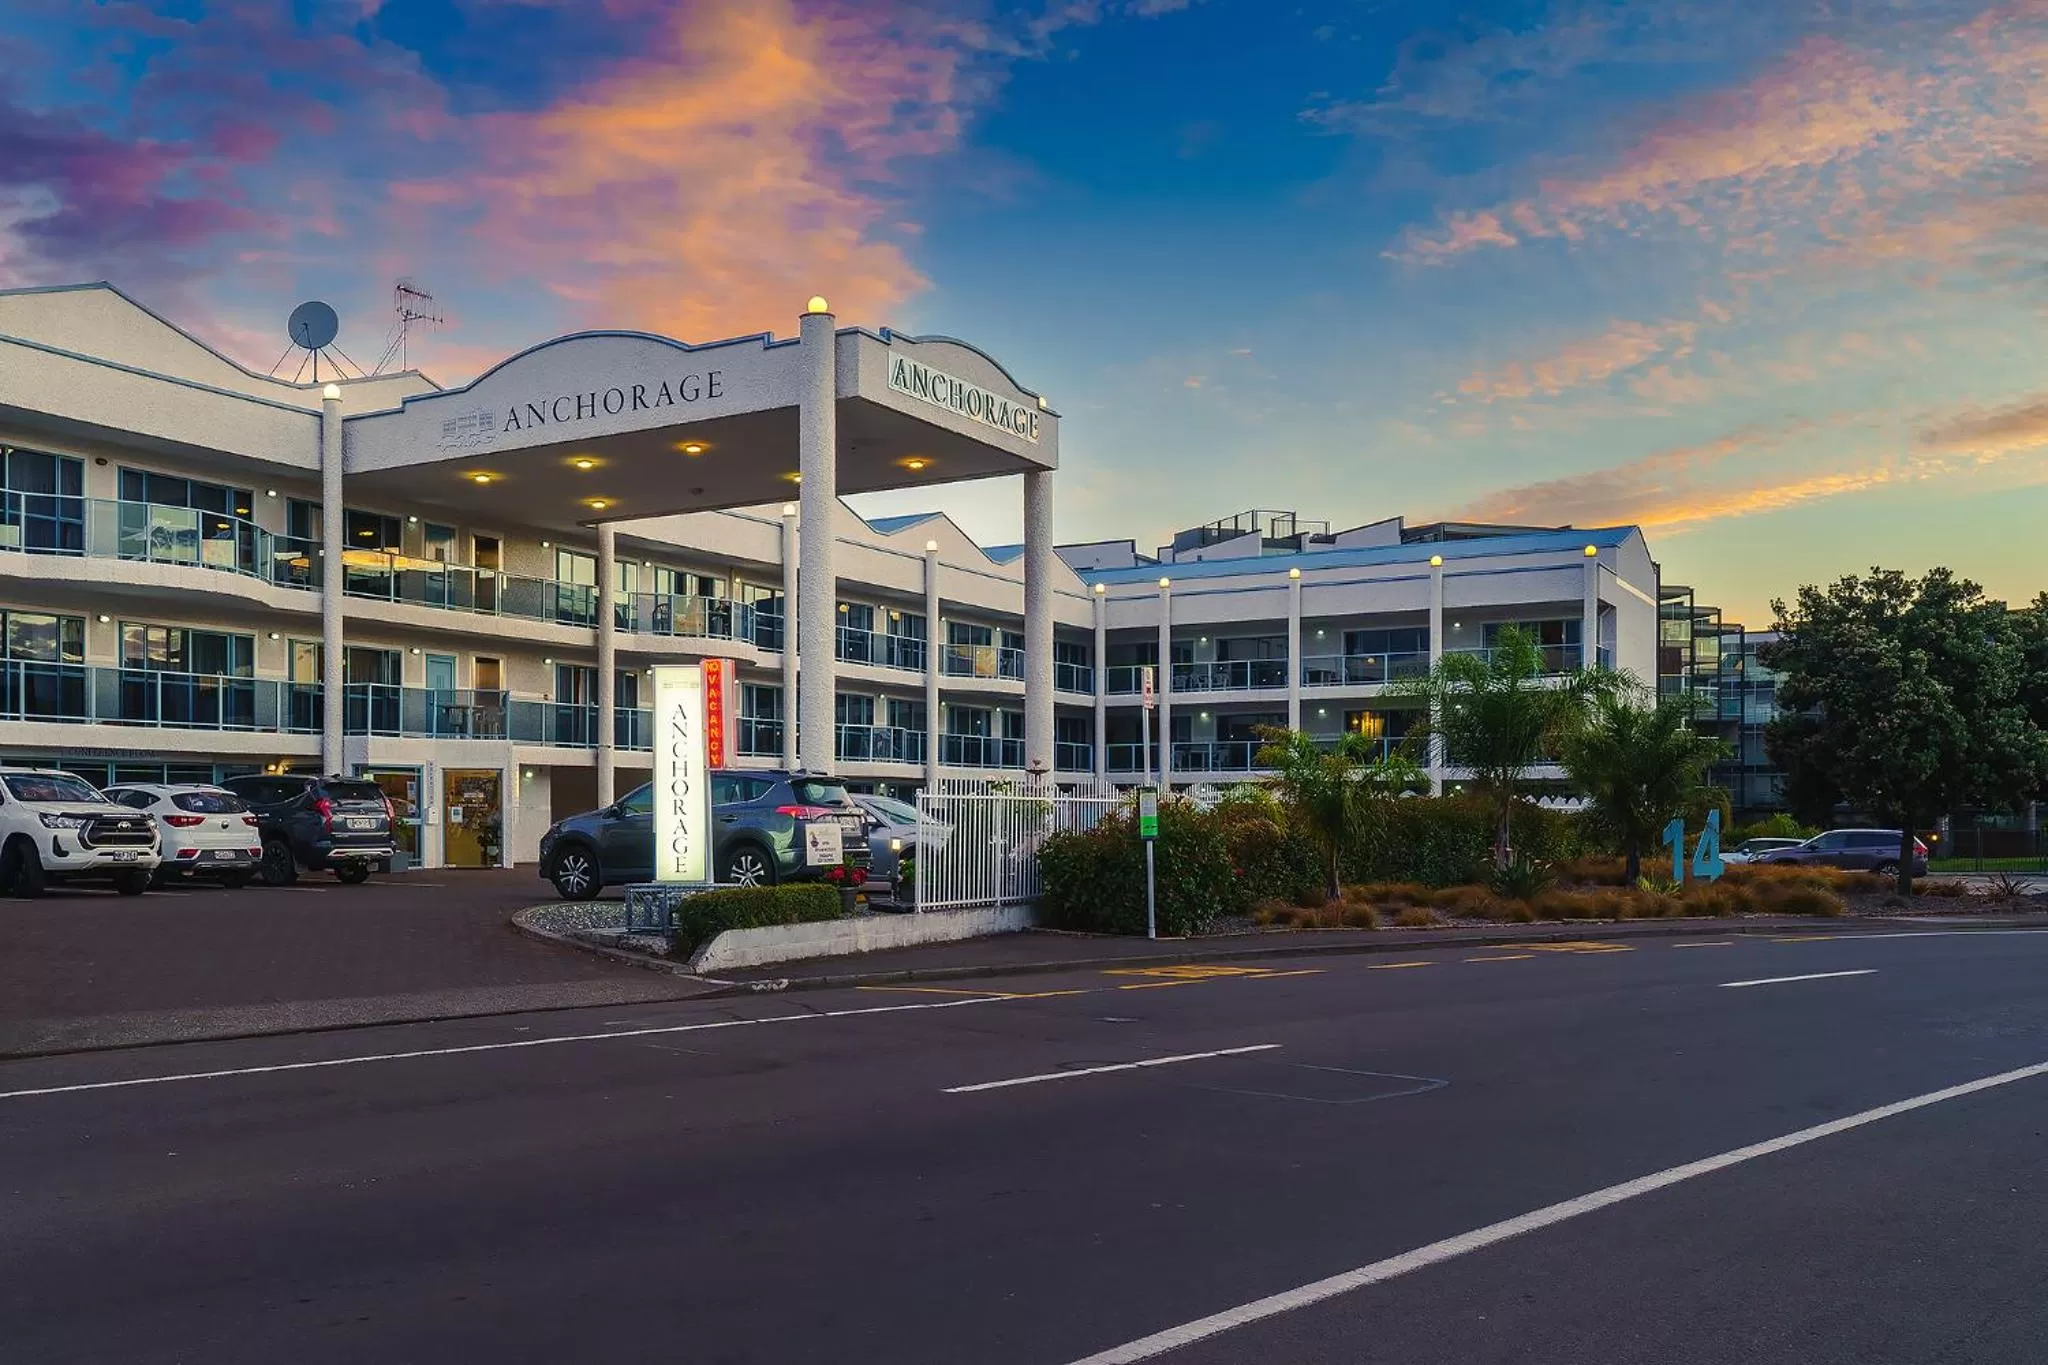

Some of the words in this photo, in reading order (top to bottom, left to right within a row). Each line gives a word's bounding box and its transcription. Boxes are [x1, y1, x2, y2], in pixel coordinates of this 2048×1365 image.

[503, 370, 724, 432] ANCHORAGE
[891, 357, 1040, 440] ANCHORAGE
[704, 661, 719, 672] NO
[707, 674, 720, 765] VACANCY
[671, 703, 689, 873] ANCHORAGE
[1663, 808, 1725, 886] 14
